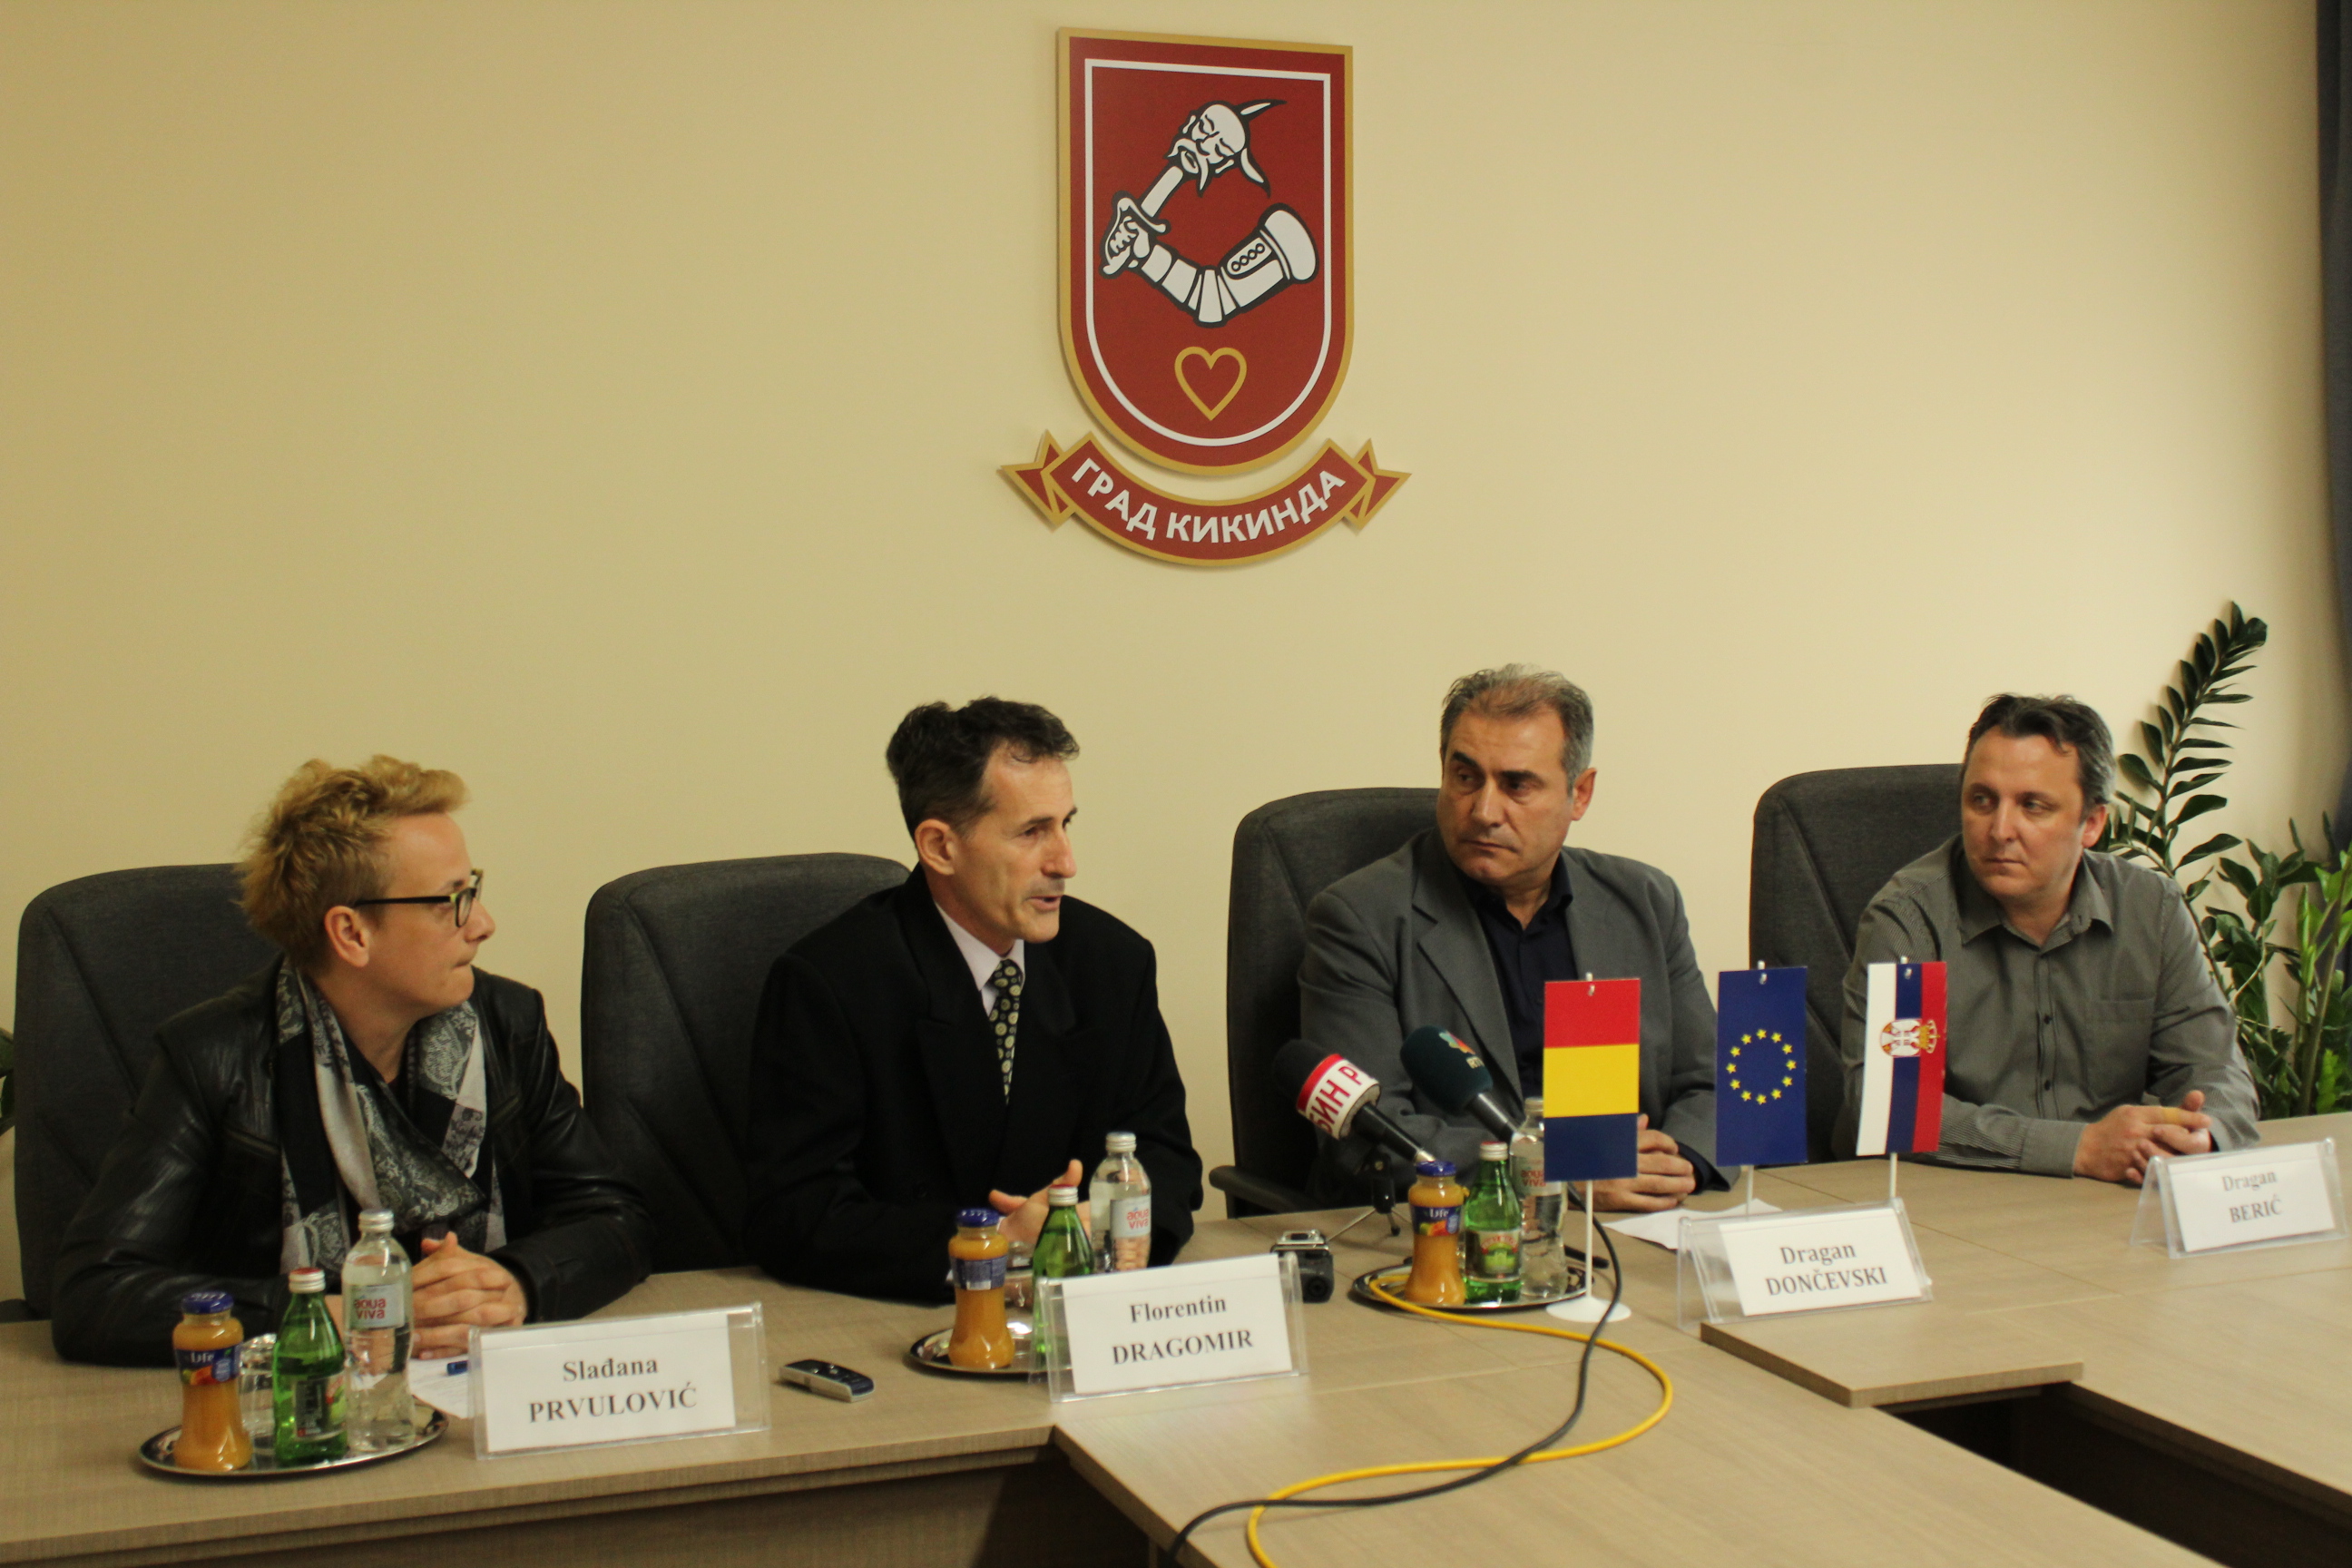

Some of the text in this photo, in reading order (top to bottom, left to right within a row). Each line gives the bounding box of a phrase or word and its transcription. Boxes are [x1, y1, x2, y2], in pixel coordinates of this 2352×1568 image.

[1071, 457, 1346, 544] ГРАД КИКИНДА
[2221, 1171, 2278, 1192] Dragan
[2229, 1193, 2282, 1224] BERIĆ
[1779, 1243, 1857, 1267] Dragan
[1764, 1266, 1888, 1297] DONČEVSKI
[1129, 1295, 1227, 1324] Florentin
[1112, 1328, 1254, 1366] DRAGOMIR
[563, 1357, 659, 1383] Slađana
[529, 1381, 697, 1423] PRVULOVIĆ
